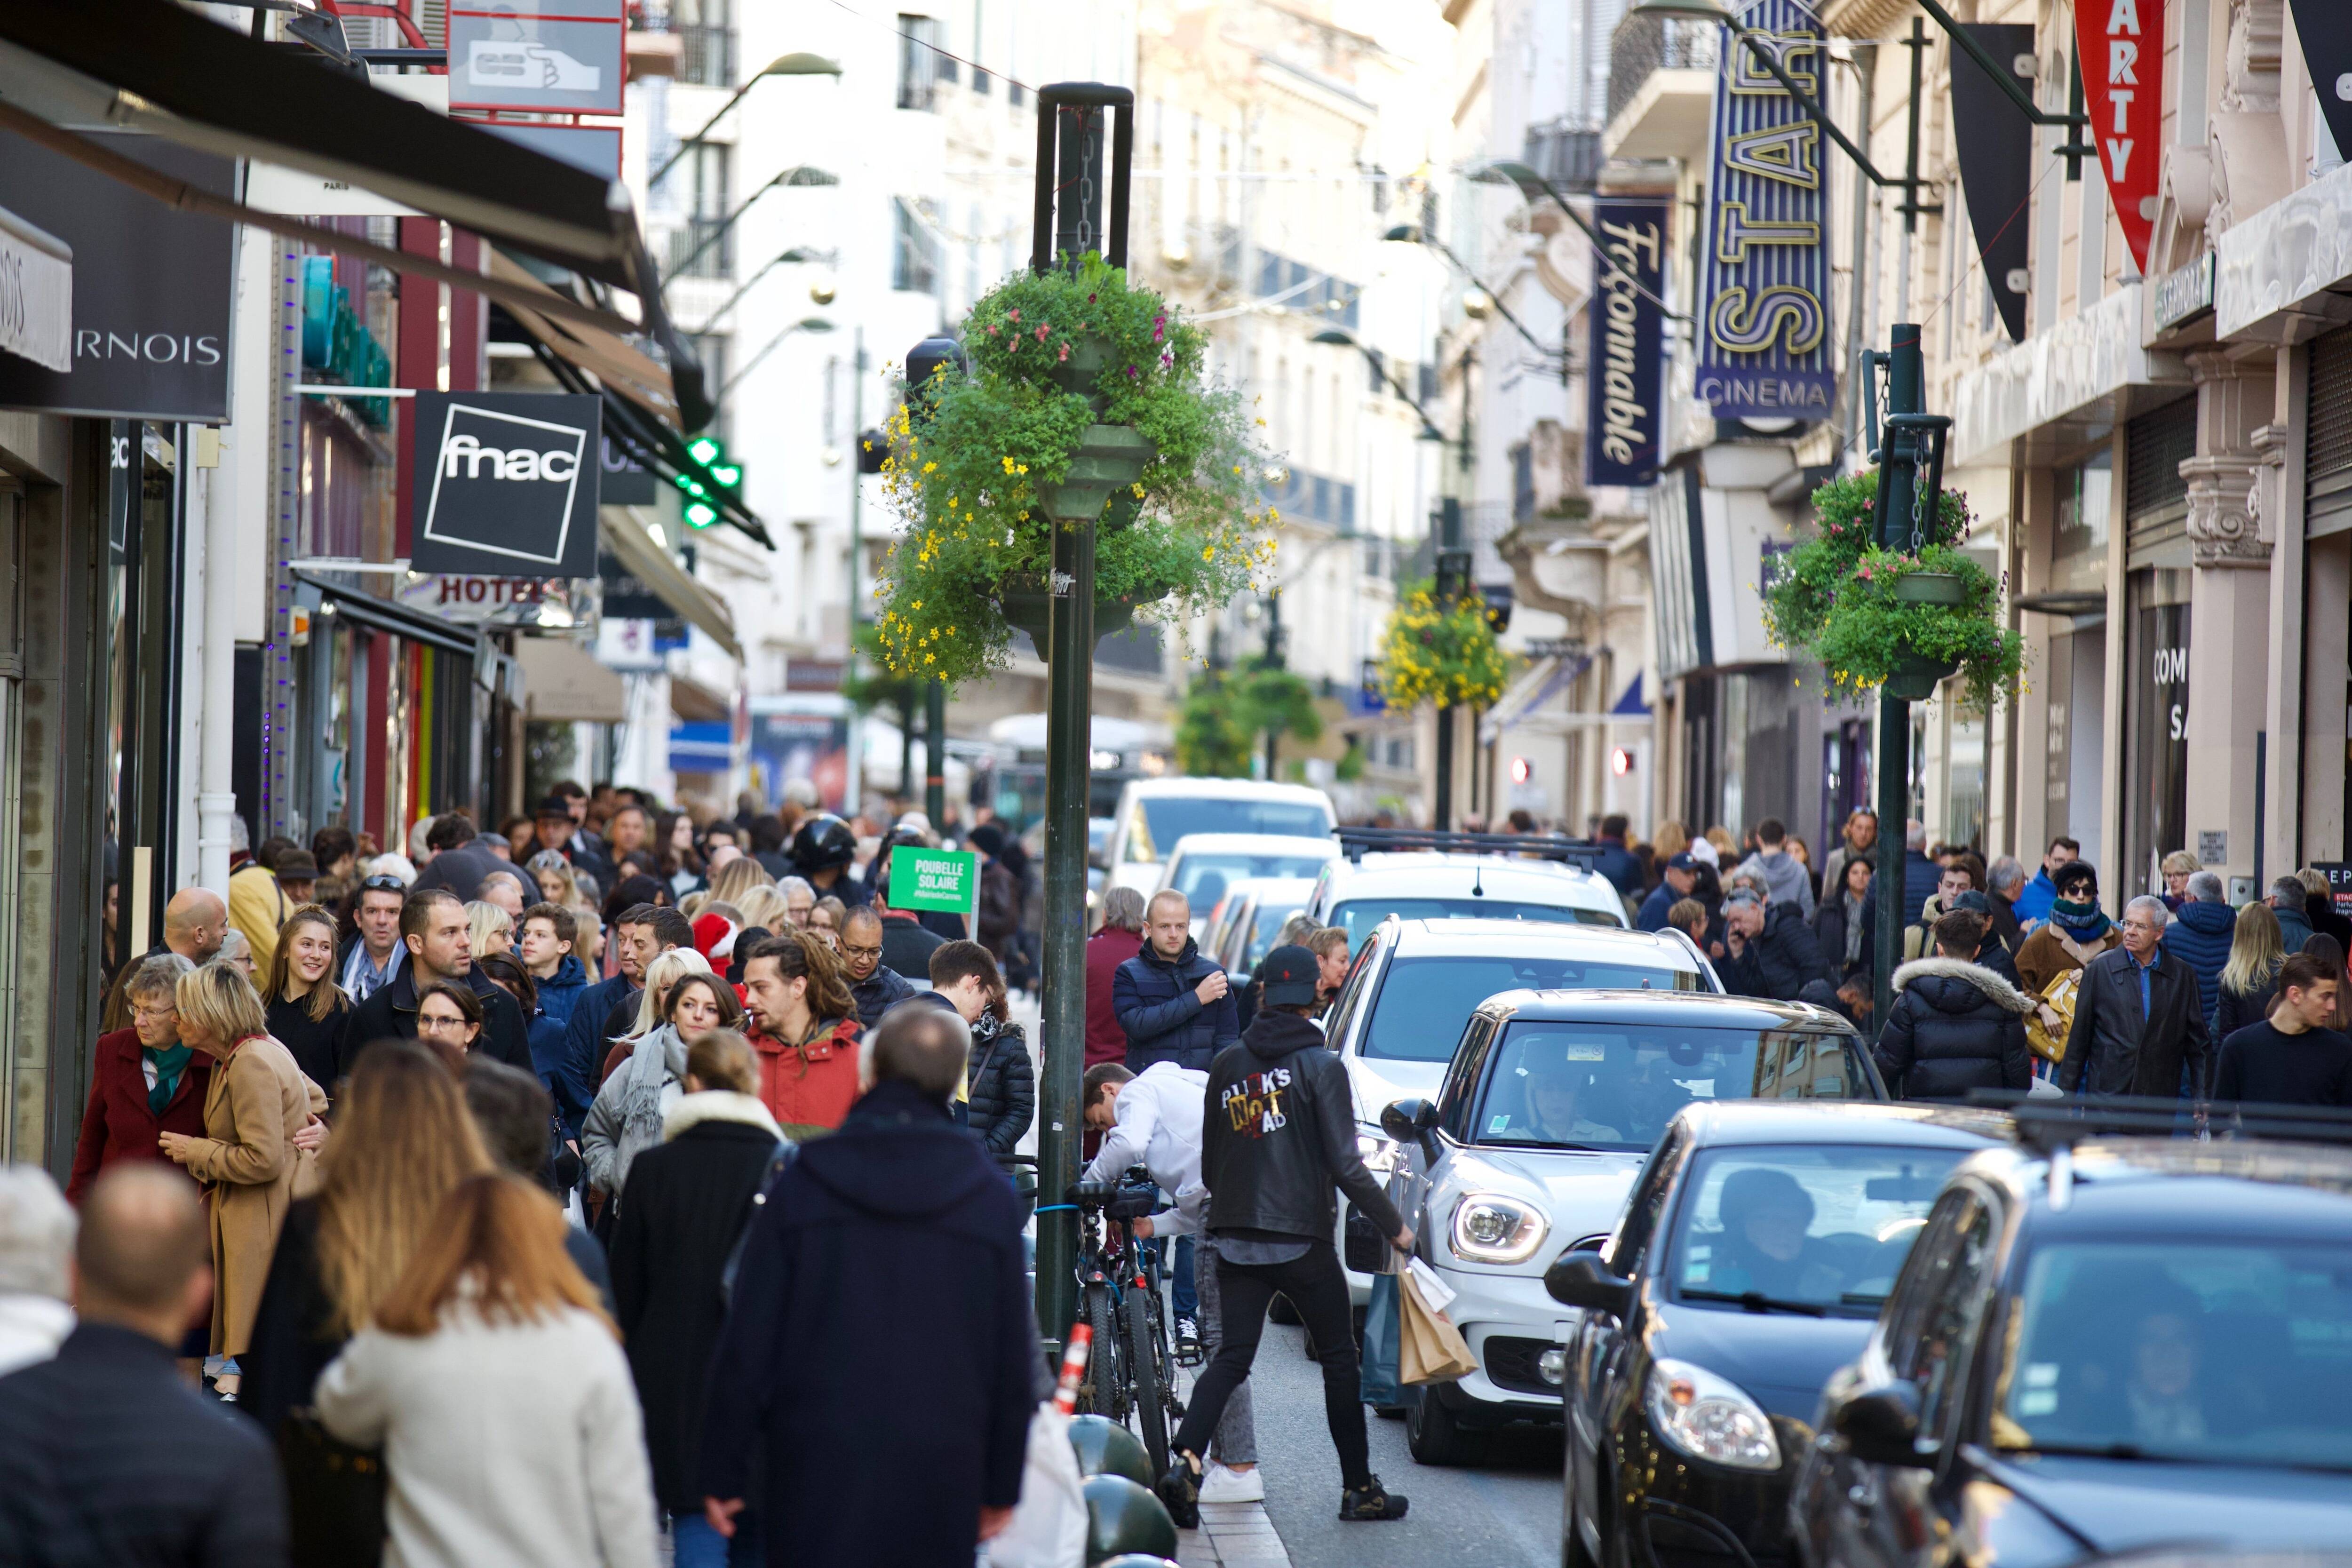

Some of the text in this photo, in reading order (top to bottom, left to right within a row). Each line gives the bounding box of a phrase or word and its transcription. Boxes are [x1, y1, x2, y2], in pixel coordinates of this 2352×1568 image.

[1709, 27, 1824, 355] STAR
[2163, 264, 2201, 323] SEPHORA
[1700, 377, 1828, 407] CINEMA
[445, 434, 577, 482] fnac
[440, 576, 544, 605] HOTEL
[2170, 704, 2189, 740] S
[915, 859, 964, 877] POUBELLE
[919, 874, 959, 891] SOLAIRE
